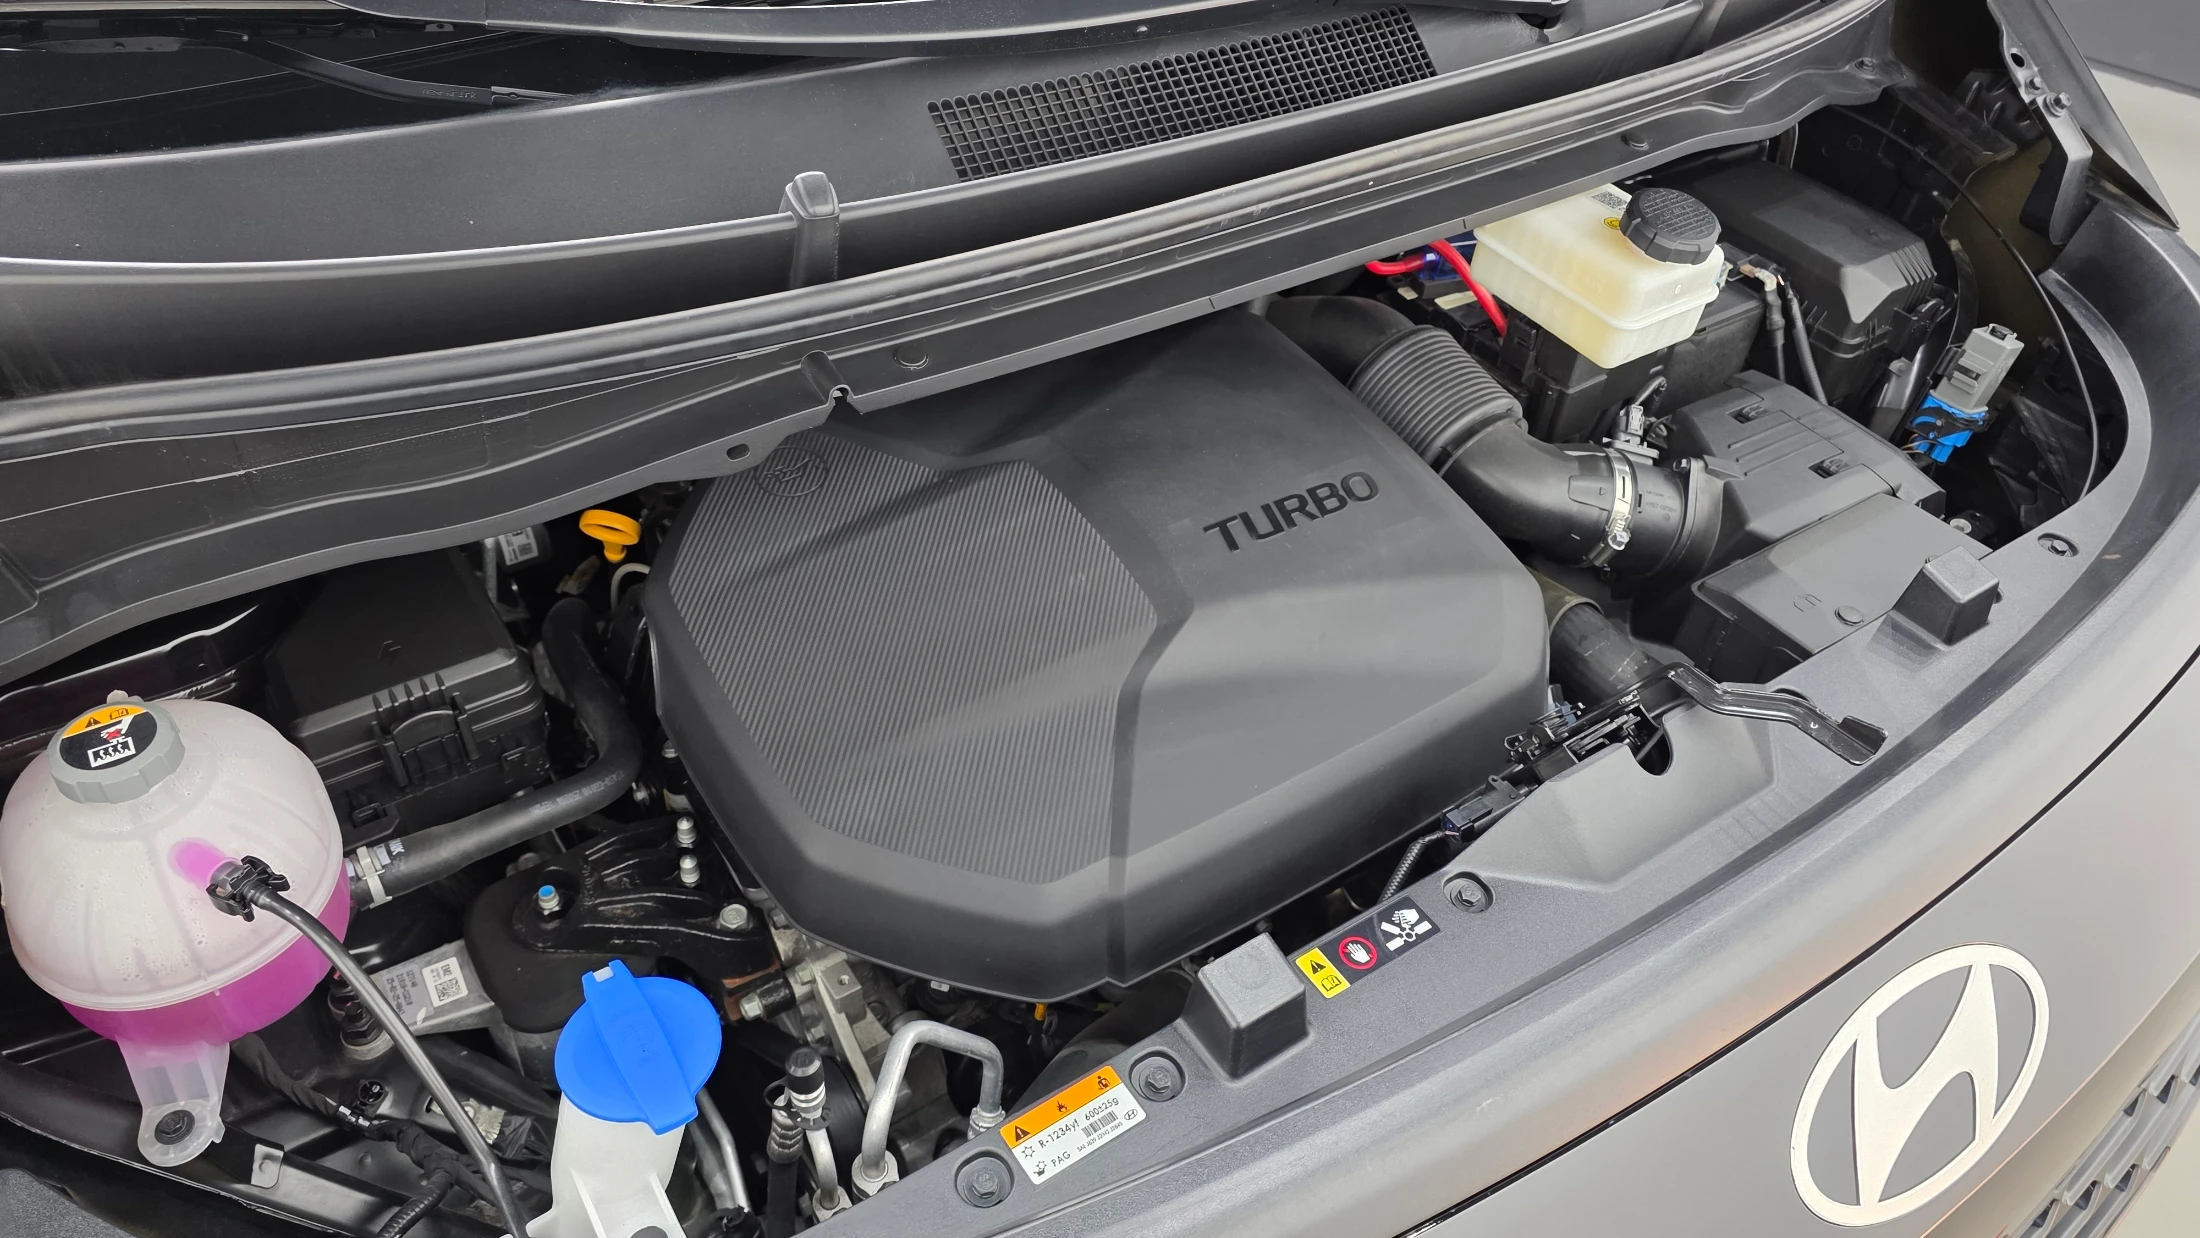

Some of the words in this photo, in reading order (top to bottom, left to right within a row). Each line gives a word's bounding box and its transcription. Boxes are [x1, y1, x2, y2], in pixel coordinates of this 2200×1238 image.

[1202, 471, 1380, 552] TURBO
[1038, 1118, 1080, 1149] R-1234yf
[1085, 1097, 1120, 1121] 600±25g
[1051, 1151, 1071, 1168] PAG
